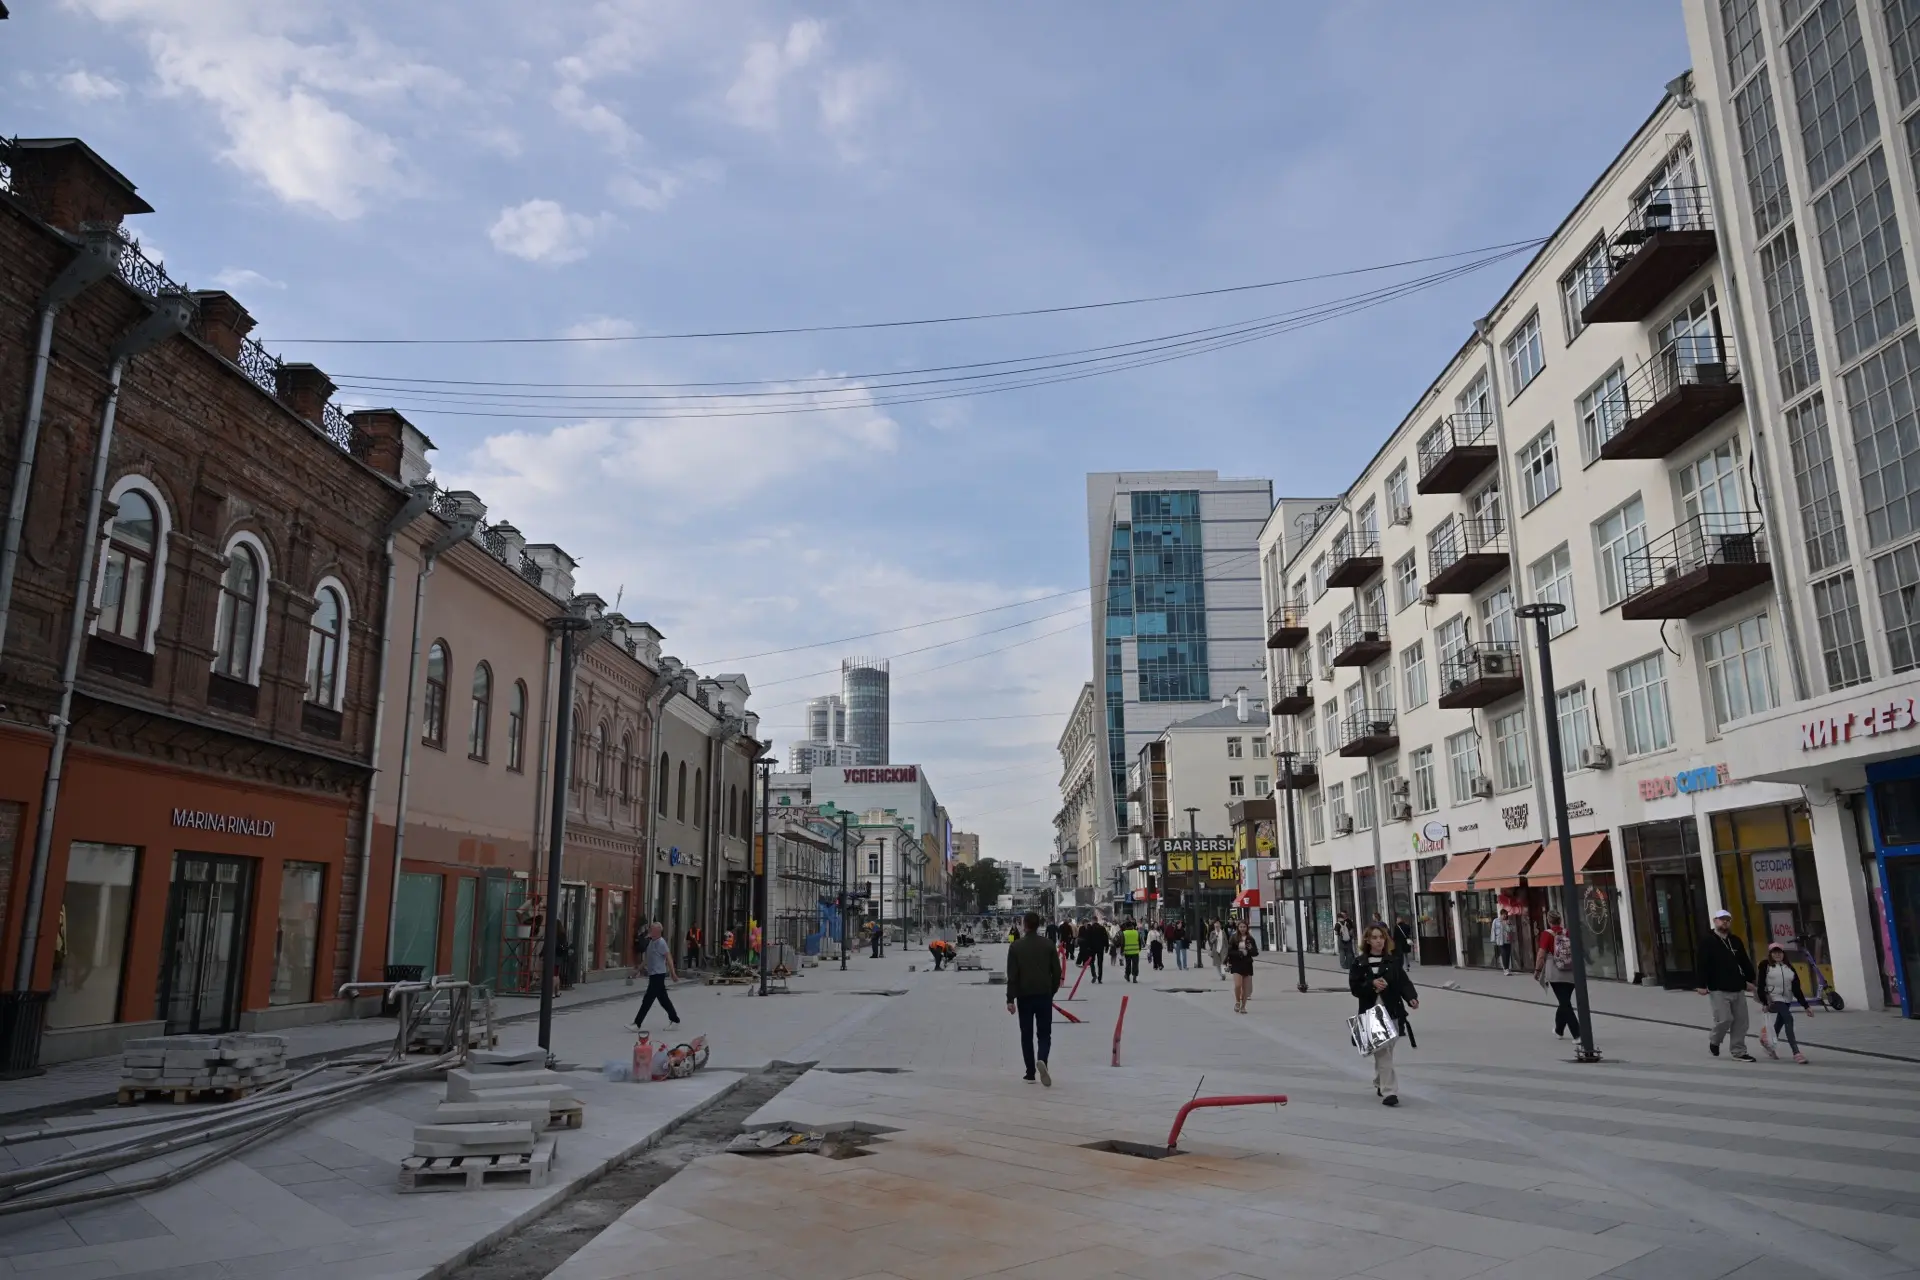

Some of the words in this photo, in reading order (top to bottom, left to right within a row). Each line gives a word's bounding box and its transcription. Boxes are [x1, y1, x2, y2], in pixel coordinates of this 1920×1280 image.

[1799, 711, 1856, 752] ХИТ
[843, 765, 917, 784] УСПЕНСКИЙ
[172, 807, 226, 832] MARINA
[227, 815, 275, 838] RINALDI
[1754, 859, 1794, 872] СЕГОДНЯ
[1210, 866, 1234, 880] BAR
[1758, 878, 1794, 892] СКИДКА
[1774, 924, 1793, 937] 40%
